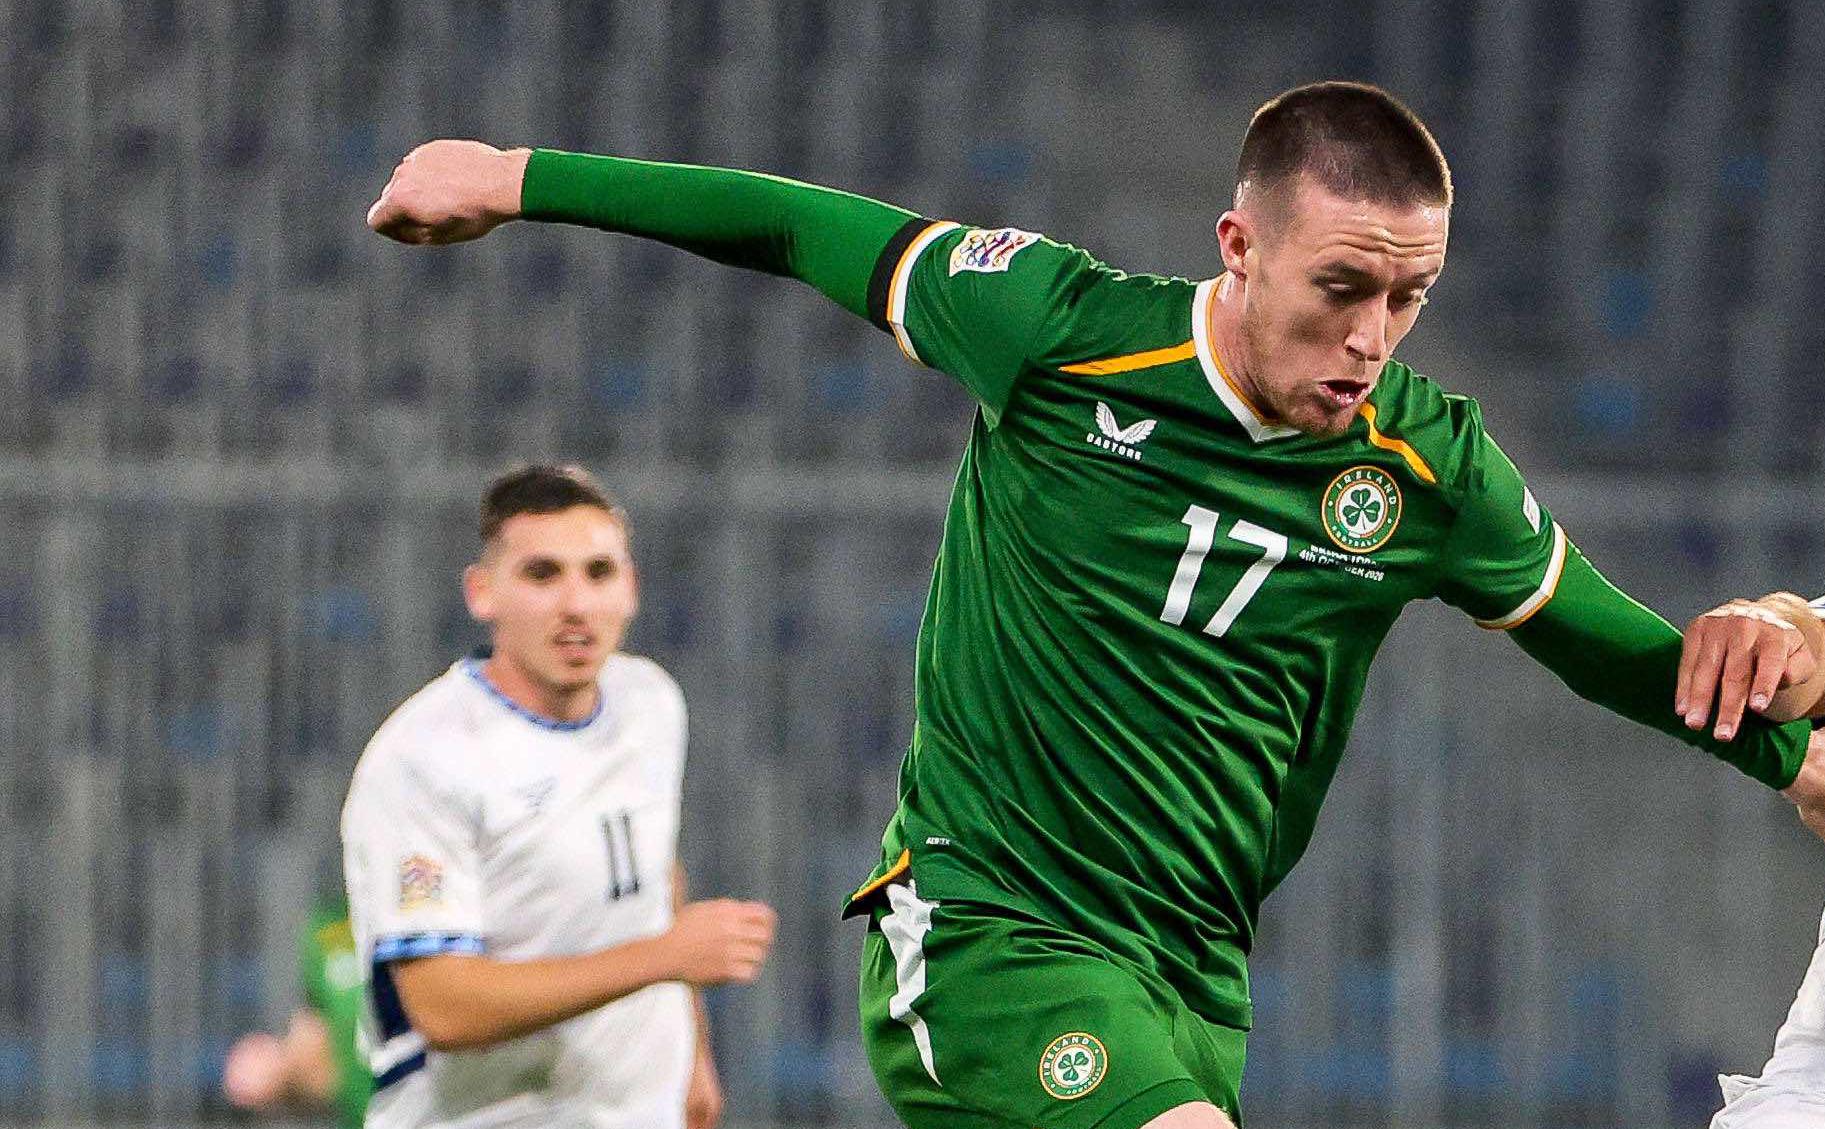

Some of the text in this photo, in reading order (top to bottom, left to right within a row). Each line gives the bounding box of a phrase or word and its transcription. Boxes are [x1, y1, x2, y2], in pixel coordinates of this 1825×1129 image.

[1086, 432, 1142, 461] CASTORE
[1336, 470, 1397, 505] IRELAND
[1160, 503, 1288, 638] 17
[600, 813, 641, 901] 11
[1043, 1036, 1090, 1077] IRELAND
